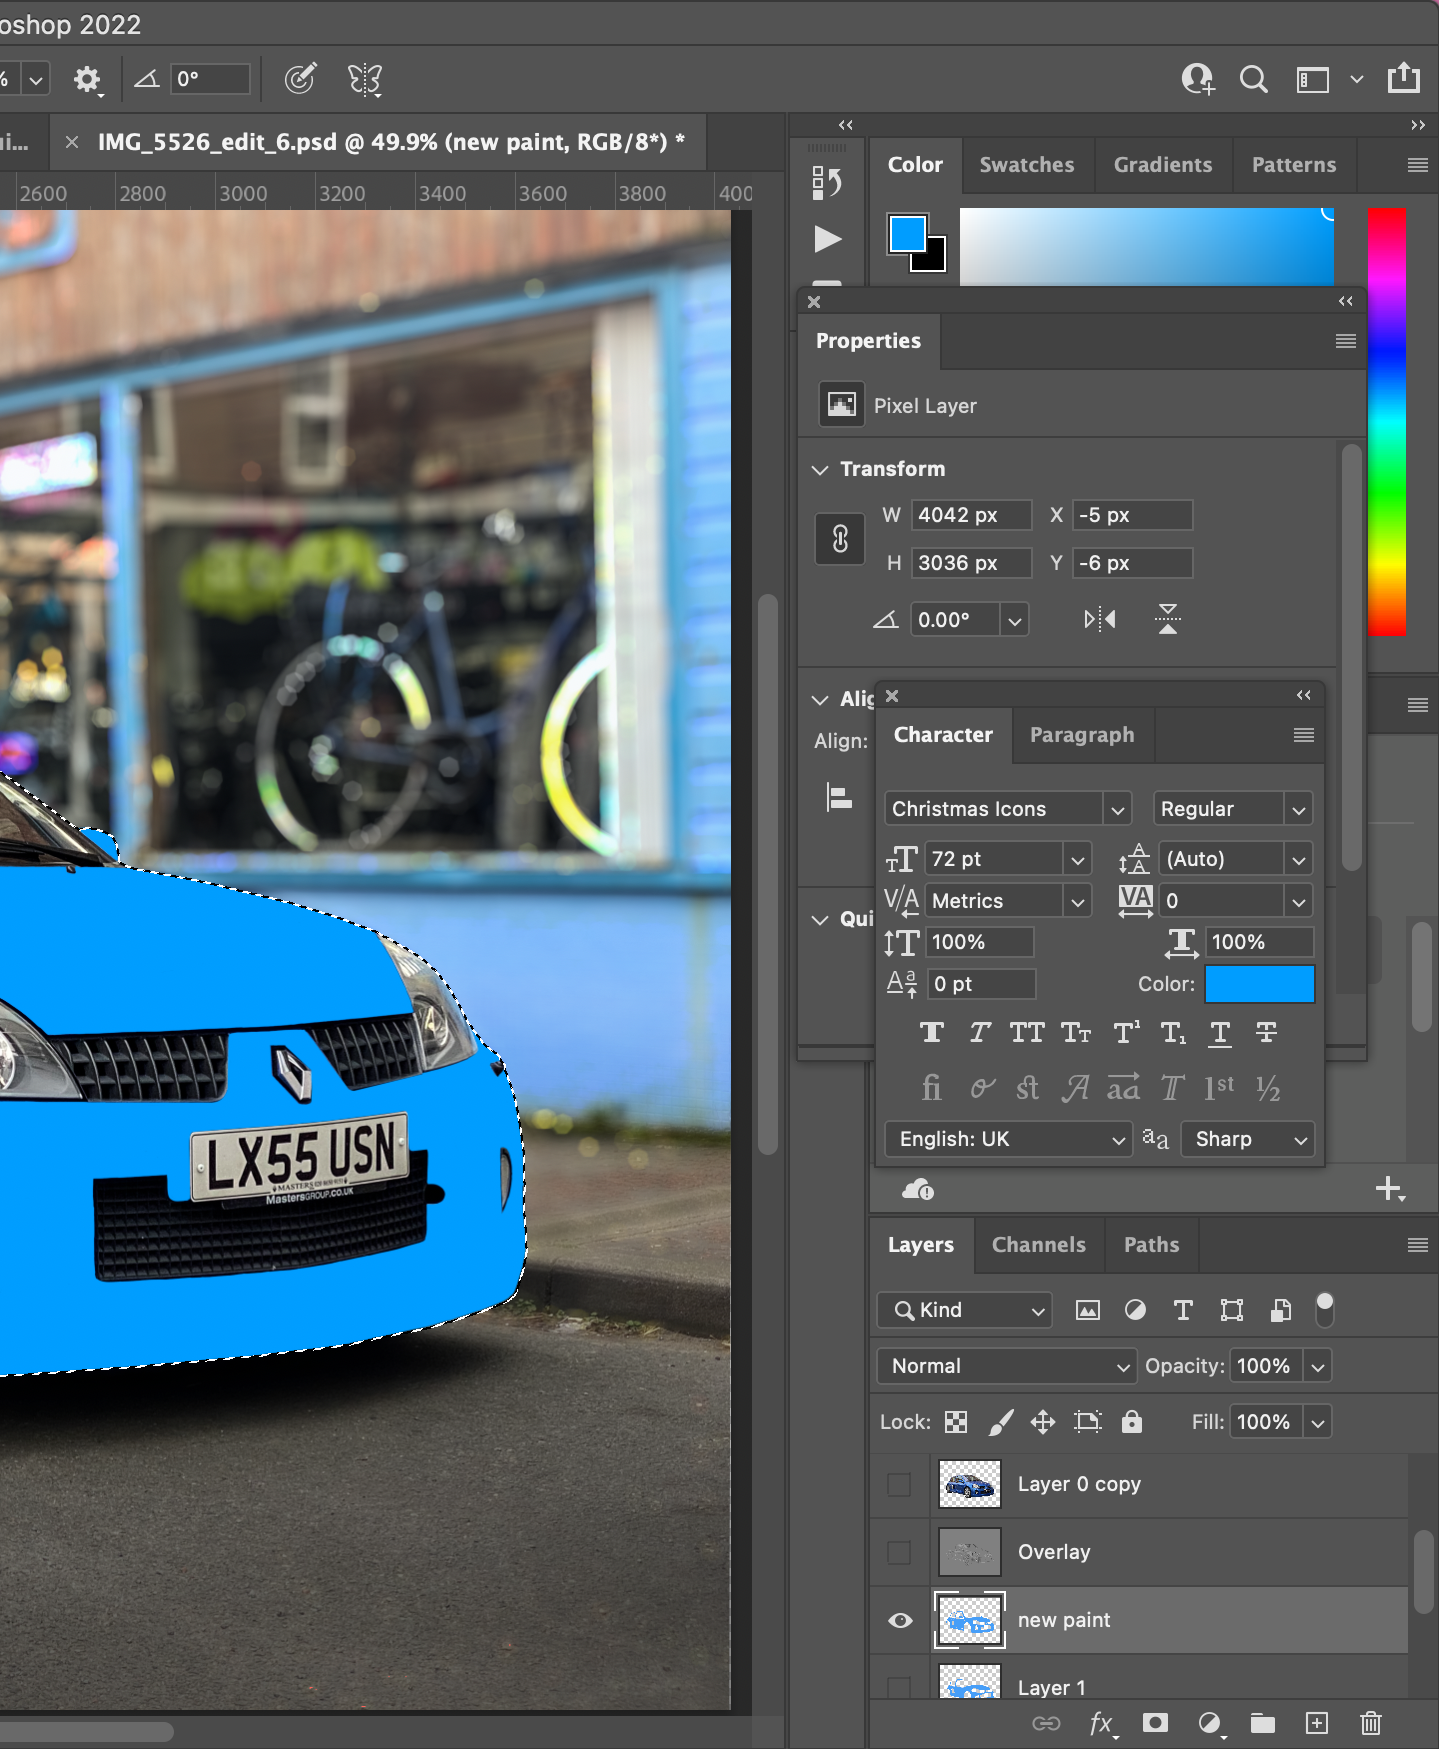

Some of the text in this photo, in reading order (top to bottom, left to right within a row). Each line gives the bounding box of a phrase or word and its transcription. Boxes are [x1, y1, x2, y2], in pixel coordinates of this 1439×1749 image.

[80, 14, 141, 35] 2022
[178, 71, 198, 87] 0°
[99, 132, 336, 155] IMG_5526_edit_6.psd
[371, 133, 438, 151] 49.9%
[445, 132, 499, 154] (new
[507, 133, 569, 155] paint,
[888, 156, 943, 173] Color
[980, 156, 1074, 173] Swatches
[1114, 156, 1212, 173] Gradients
[1253, 157, 1336, 172] Patterns
[20, 186, 67, 201] 2600
[120, 186, 166, 201] 2800
[220, 186, 267, 201] 3000
[320, 186, 365, 201] 3200
[420, 186, 466, 201] 3400
[520, 186, 567, 201] 3600
[620, 186, 666, 201] 3800
[817, 332, 921, 352] Properties
[875, 397, 977, 417] Pixel Layer
[840, 460, 945, 477] Transform
[882, 507, 901, 522] W
[919, 507, 997, 526] 4042 px
[1050, 507, 1063, 522] X
[1080, 507, 1129, 526] -5 px
[888, 555, 901, 570] H
[919, 555, 997, 574] 3036 px
[1050, 555, 1063, 570] Y
[1080, 555, 1129, 574] -6 px
[919, 612, 969, 628] 0.00°
[814, 732, 867, 752] Align:
[894, 726, 993, 743] Character
[1031, 726, 1134, 746] Paragraph
[893, 800, 1046, 817] Christmas Icons
[1162, 800, 1234, 820] Regular
[932, 851, 981, 870] 72 pt
[1168, 850, 1224, 870] (Auto)
[933, 892, 1003, 908] Metrics
[1167, 893, 1178, 909] 0
[933, 934, 985, 950] 100%
[1213, 934, 1265, 950] 100%
[935, 976, 972, 995] 0 pt
[1139, 975, 1194, 992] Color:
[901, 1130, 1010, 1150] English: UK
[1197, 1130, 1252, 1150] Sharp
[208, 1121, 395, 1191] LX55 USN
[889, 1237, 954, 1256] Layers
[992, 1236, 1086, 1253] Channels
[1125, 1236, 1179, 1252] Paths
[921, 1301, 961, 1317] Kind
[893, 1357, 960, 1373] Normal
[1146, 1357, 1224, 1377] Opacity:
[1238, 1358, 1290, 1374] 100%
[881, 1413, 930, 1429] Lock:
[1193, 1413, 1224, 1429] Fill:
[1238, 1414, 1290, 1430] 100%
[1019, 1476, 1141, 1495] Layer 0 copy
[1019, 1543, 1091, 1563] Overlay
[1019, 1611, 1110, 1631] new paint
[1019, 1680, 1084, 1697] Layer 1
